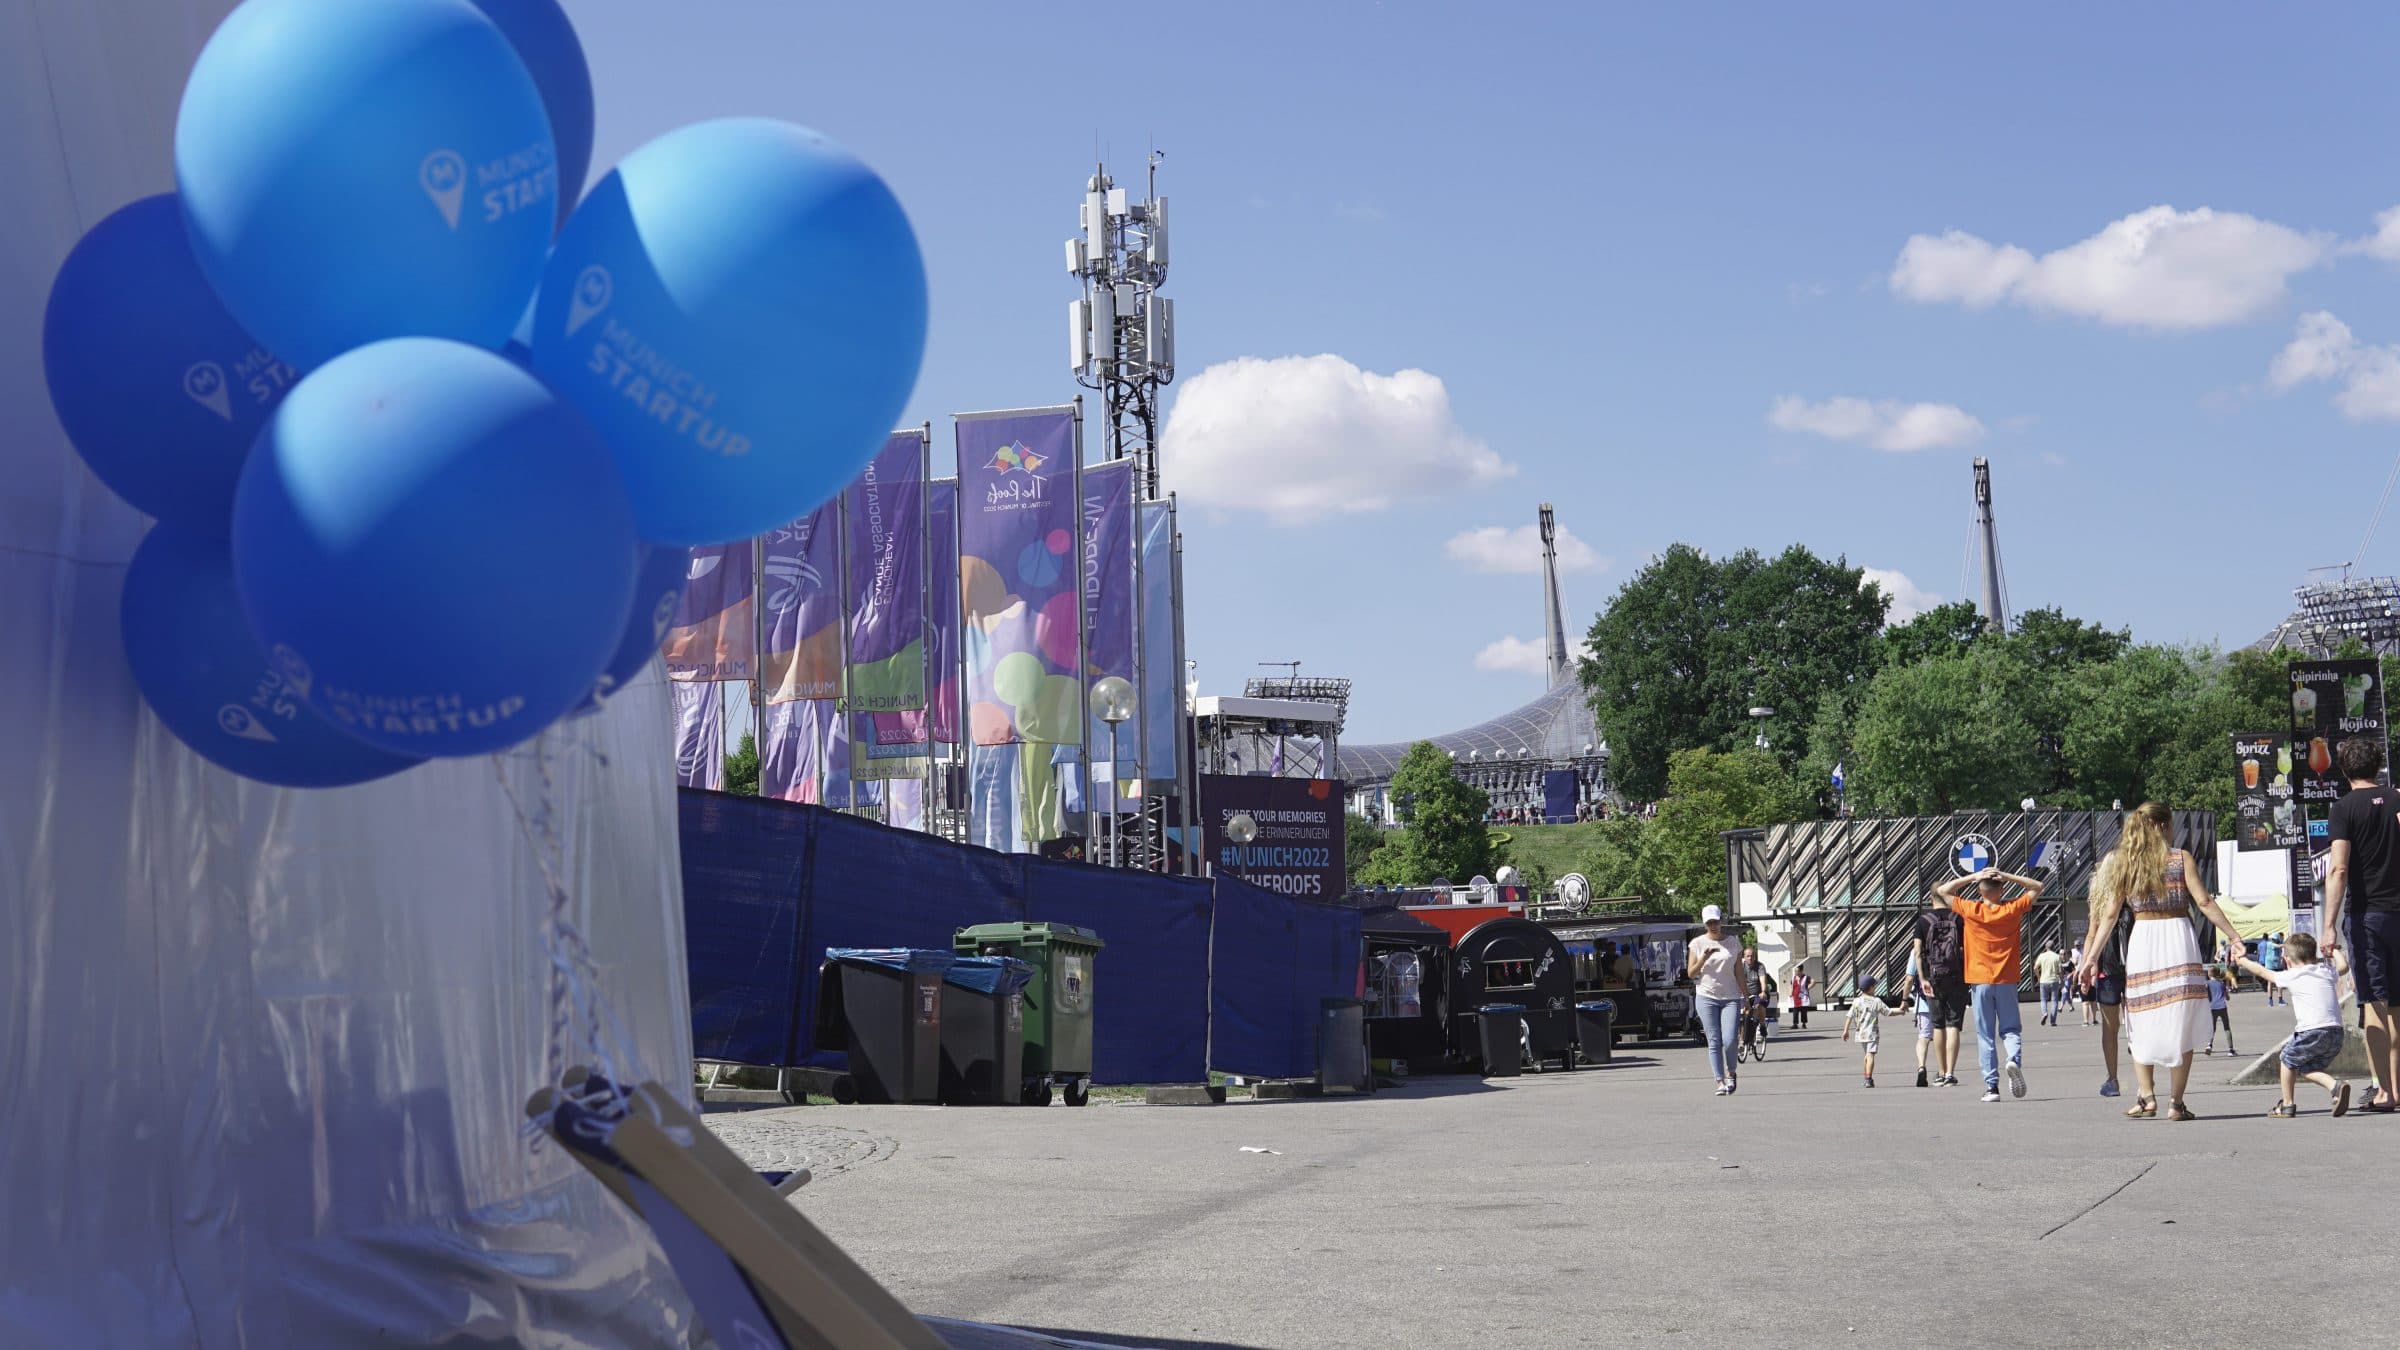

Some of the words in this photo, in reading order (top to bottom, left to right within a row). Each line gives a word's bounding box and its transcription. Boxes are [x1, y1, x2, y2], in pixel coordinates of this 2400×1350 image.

[476, 142, 550, 187] MUNIC
[602, 317, 717, 410] MUNICH
[587, 344, 752, 457] STARTUP
[2291, 670, 2338, 684] Caipirinha
[324, 683, 462, 713] MUNICH
[333, 694, 525, 733] STARTUP
[2339, 717, 2377, 732] Mojito
[2236, 741, 2270, 755] Sprizz
[2303, 778, 2318, 788] Sex
[2268, 783, 2293, 798] Hugo
[2301, 788, 2339, 799] Beach
[1252, 810, 1276, 822] YOUR
[1278, 811, 1327, 823] MEMORIES!
[2244, 806, 2260, 817] COLA
[1266, 826, 1330, 839] ERINNERUNGEN!
[2285, 825, 2302, 835] Gin
[1955, 837, 1991, 851] BMW
[2274, 834, 2305, 845] Tonic
[1221, 846, 1330, 867] #MUNICH2022
